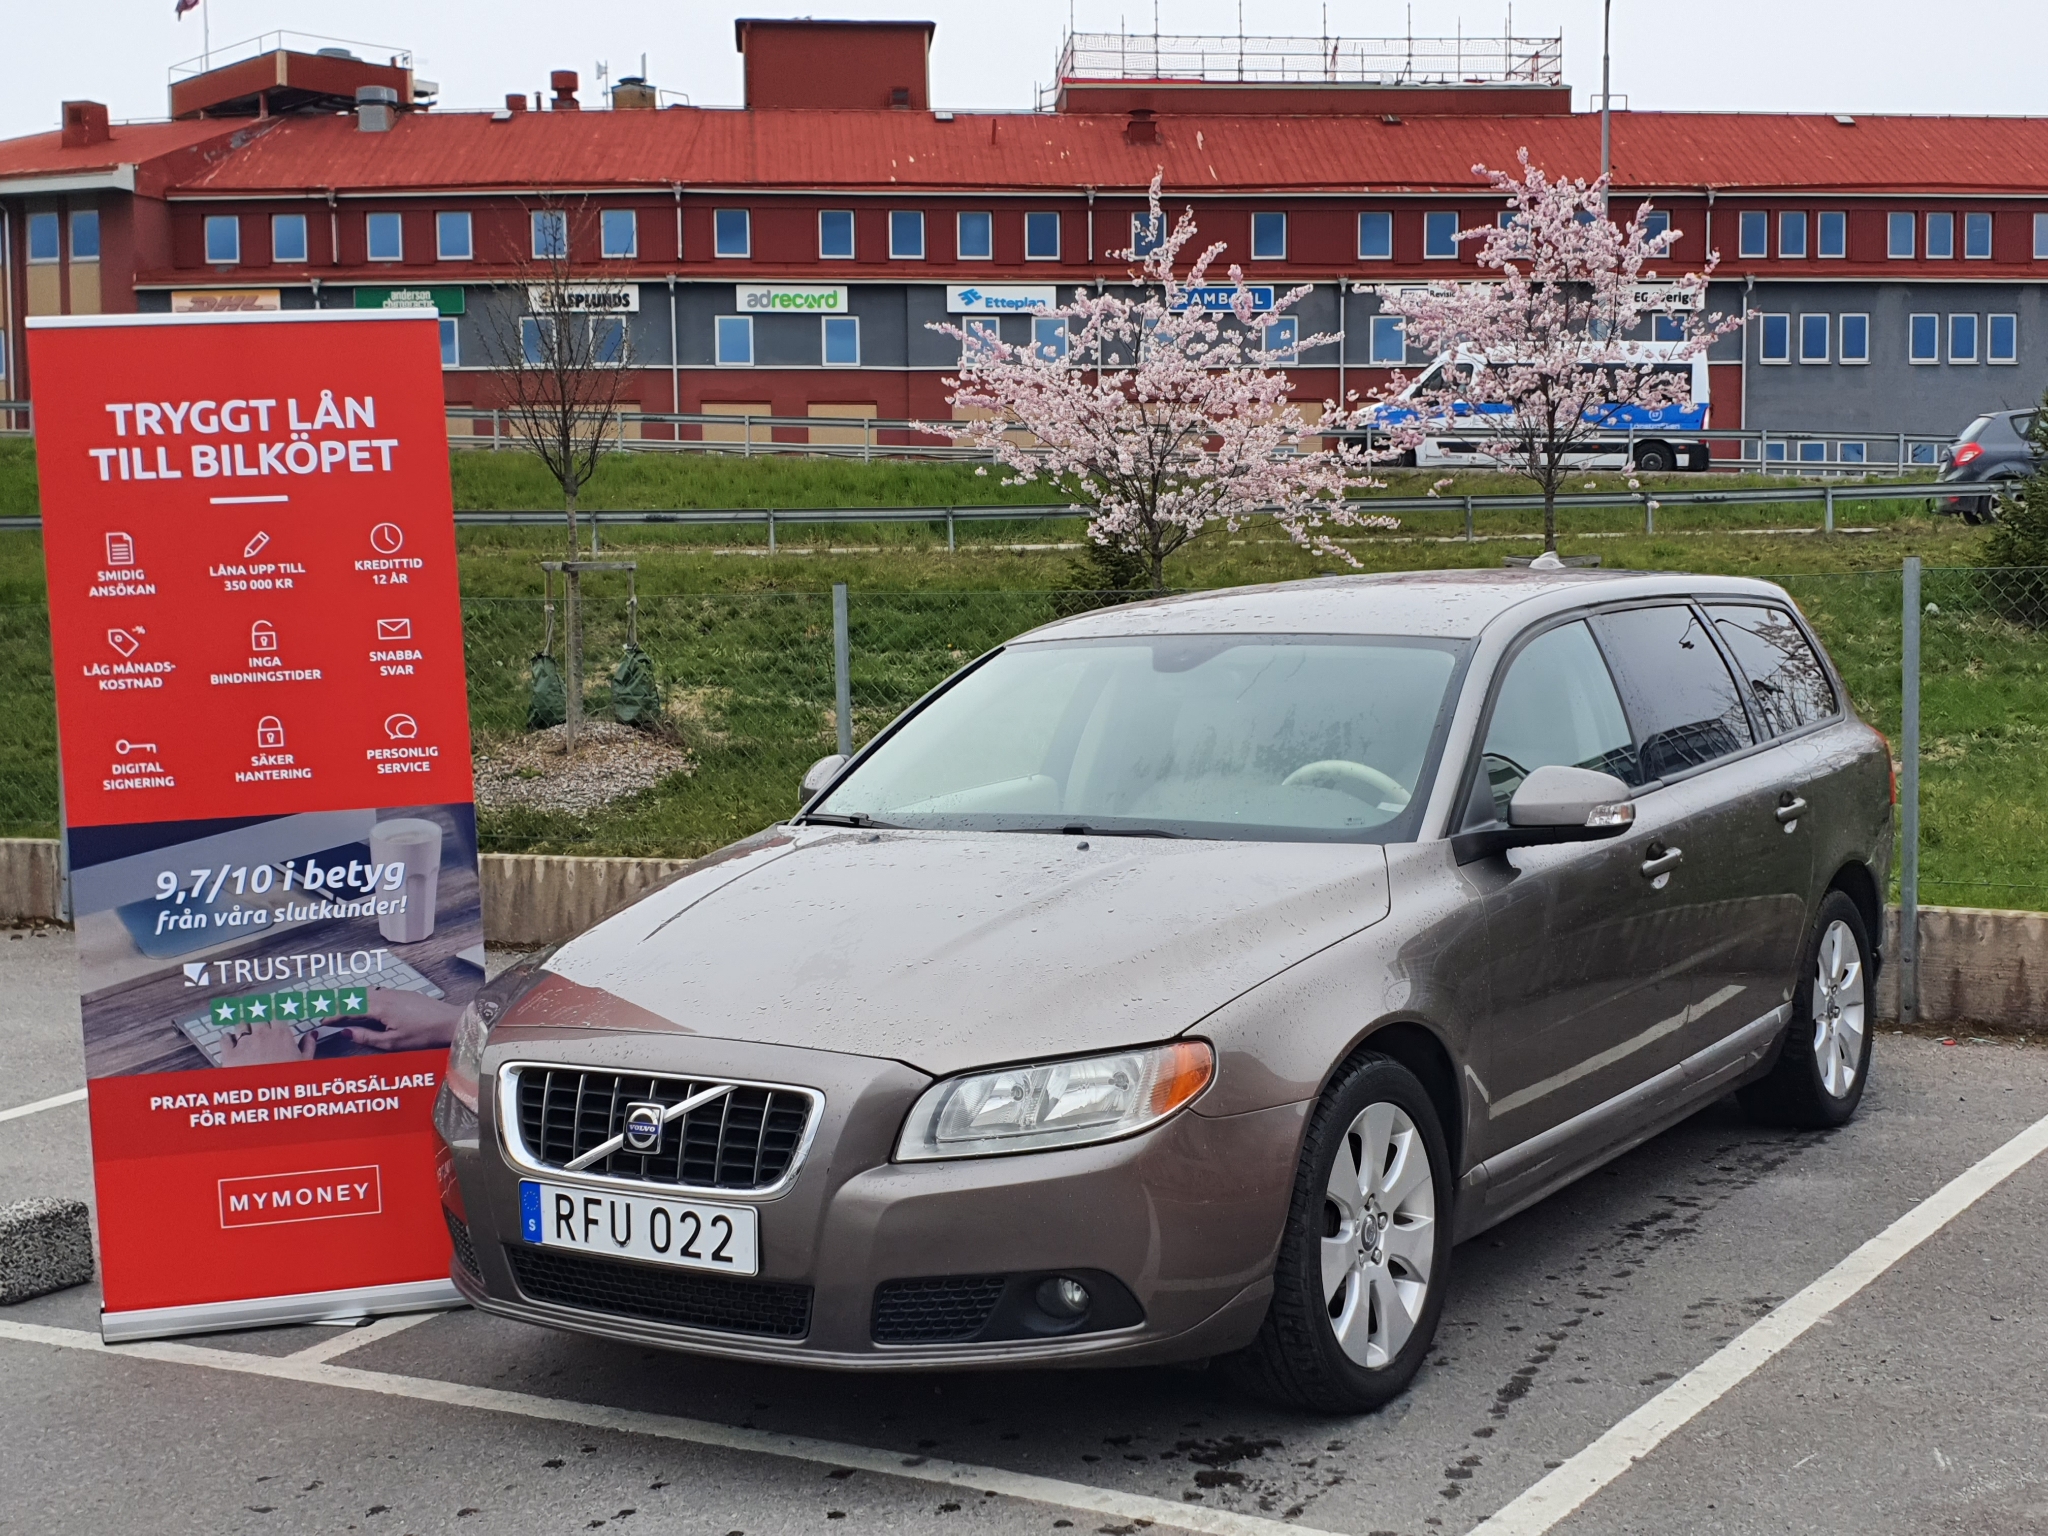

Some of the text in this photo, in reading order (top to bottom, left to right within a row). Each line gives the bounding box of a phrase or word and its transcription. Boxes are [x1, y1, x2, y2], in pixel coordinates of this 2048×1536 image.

[391, 288, 431, 301] anderson
[747, 290, 838, 309] adrecord
[1634, 291, 1649, 302] EG
[190, 295, 263, 312] DHL
[106, 389, 375, 436] TRYGGT LÅN
[89, 432, 398, 481] TILL BILKÖPET
[209, 562, 306, 577] LÅNA UPP TILL
[354, 557, 423, 571] KREDITTID
[97, 569, 145, 582] SMIDIG
[372, 571, 408, 585] 12 ÅR
[89, 582, 156, 597] ANSÖKAN
[224, 577, 294, 592] 350 000 KR
[248, 656, 281, 668] INGA
[369, 649, 423, 662] SNABBA
[83, 661, 176, 676] LÅG MÅNADS-
[380, 664, 414, 677] SVAR
[99, 676, 163, 691] KOSTNAD
[210, 669, 322, 685] BINDNINGSTIDER
[251, 753, 294, 767] SÄKER
[366, 746, 439, 760] PERSONLIG
[112, 761, 164, 775] DIGITAL
[235, 767, 312, 783] HANTERING
[376, 761, 431, 775] SERVICE
[103, 775, 175, 791] SIGNERING
[155, 859, 405, 905] 9,7/10 i betyg
[155, 895, 408, 936] från våra slutkunder!
[213, 949, 389, 984] TRUSTPILOT
[150, 1072, 435, 1112] PRATA MED DIN BILFÖRSÄLJARE
[190, 1096, 399, 1128] FÖR MER INFORMATION
[629, 1124, 656, 1133] VOLVO
[229, 1182, 370, 1212] MYMONEY
[528, 1218, 537, 1232] S
[555, 1193, 734, 1262] RFU 022
